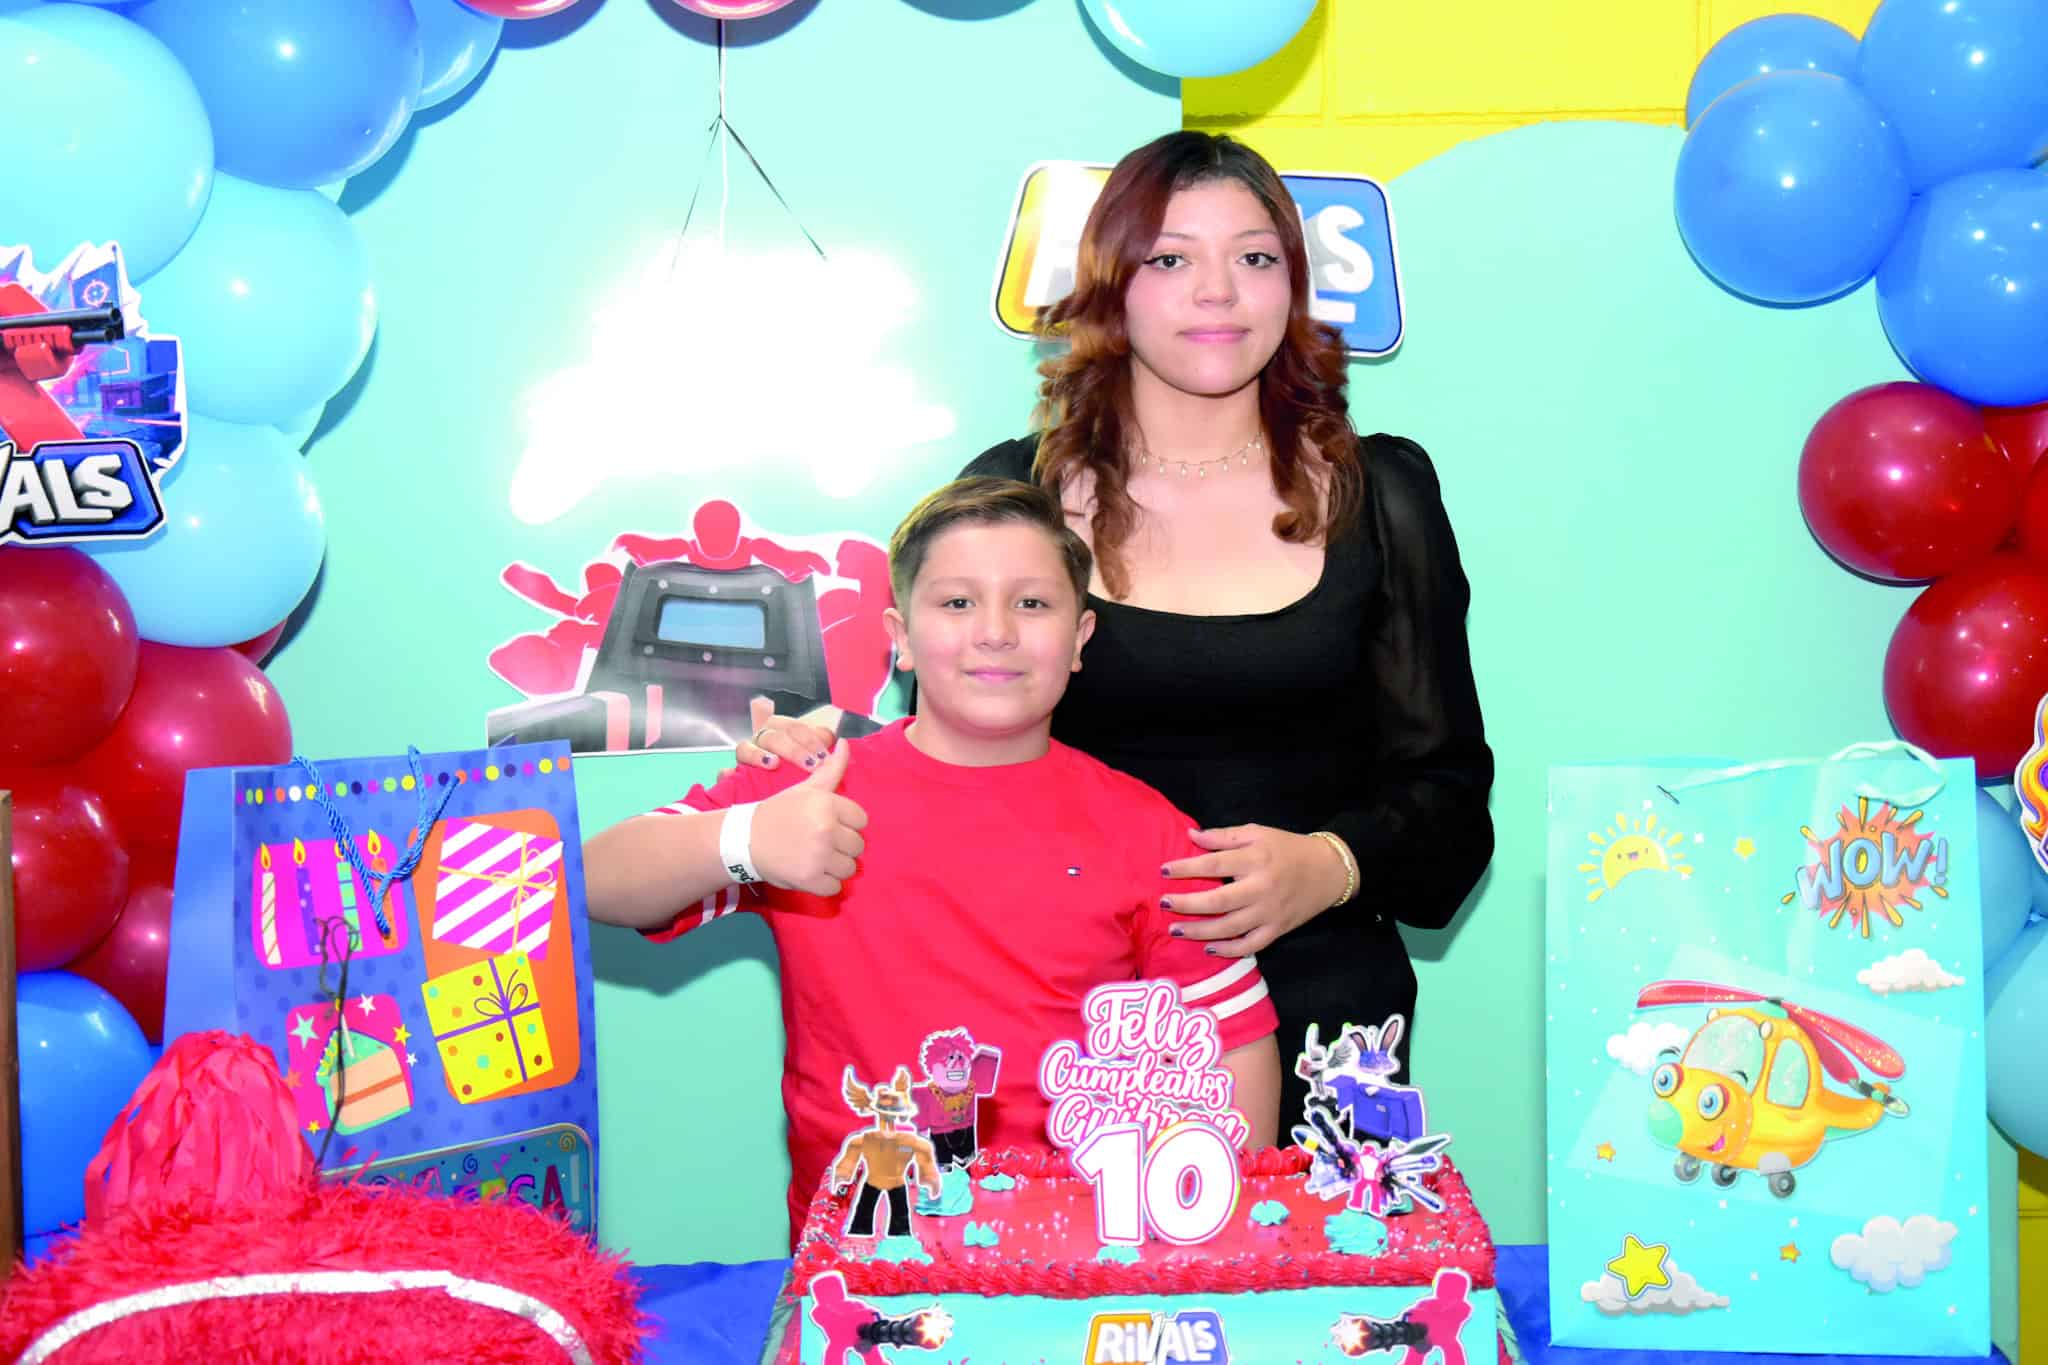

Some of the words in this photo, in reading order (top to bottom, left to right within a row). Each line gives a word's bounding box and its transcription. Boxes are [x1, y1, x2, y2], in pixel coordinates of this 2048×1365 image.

[1796, 831, 1949, 910] WOW!
[1085, 985, 1216, 1072] Feliz
[1074, 1127, 1237, 1243] 10
